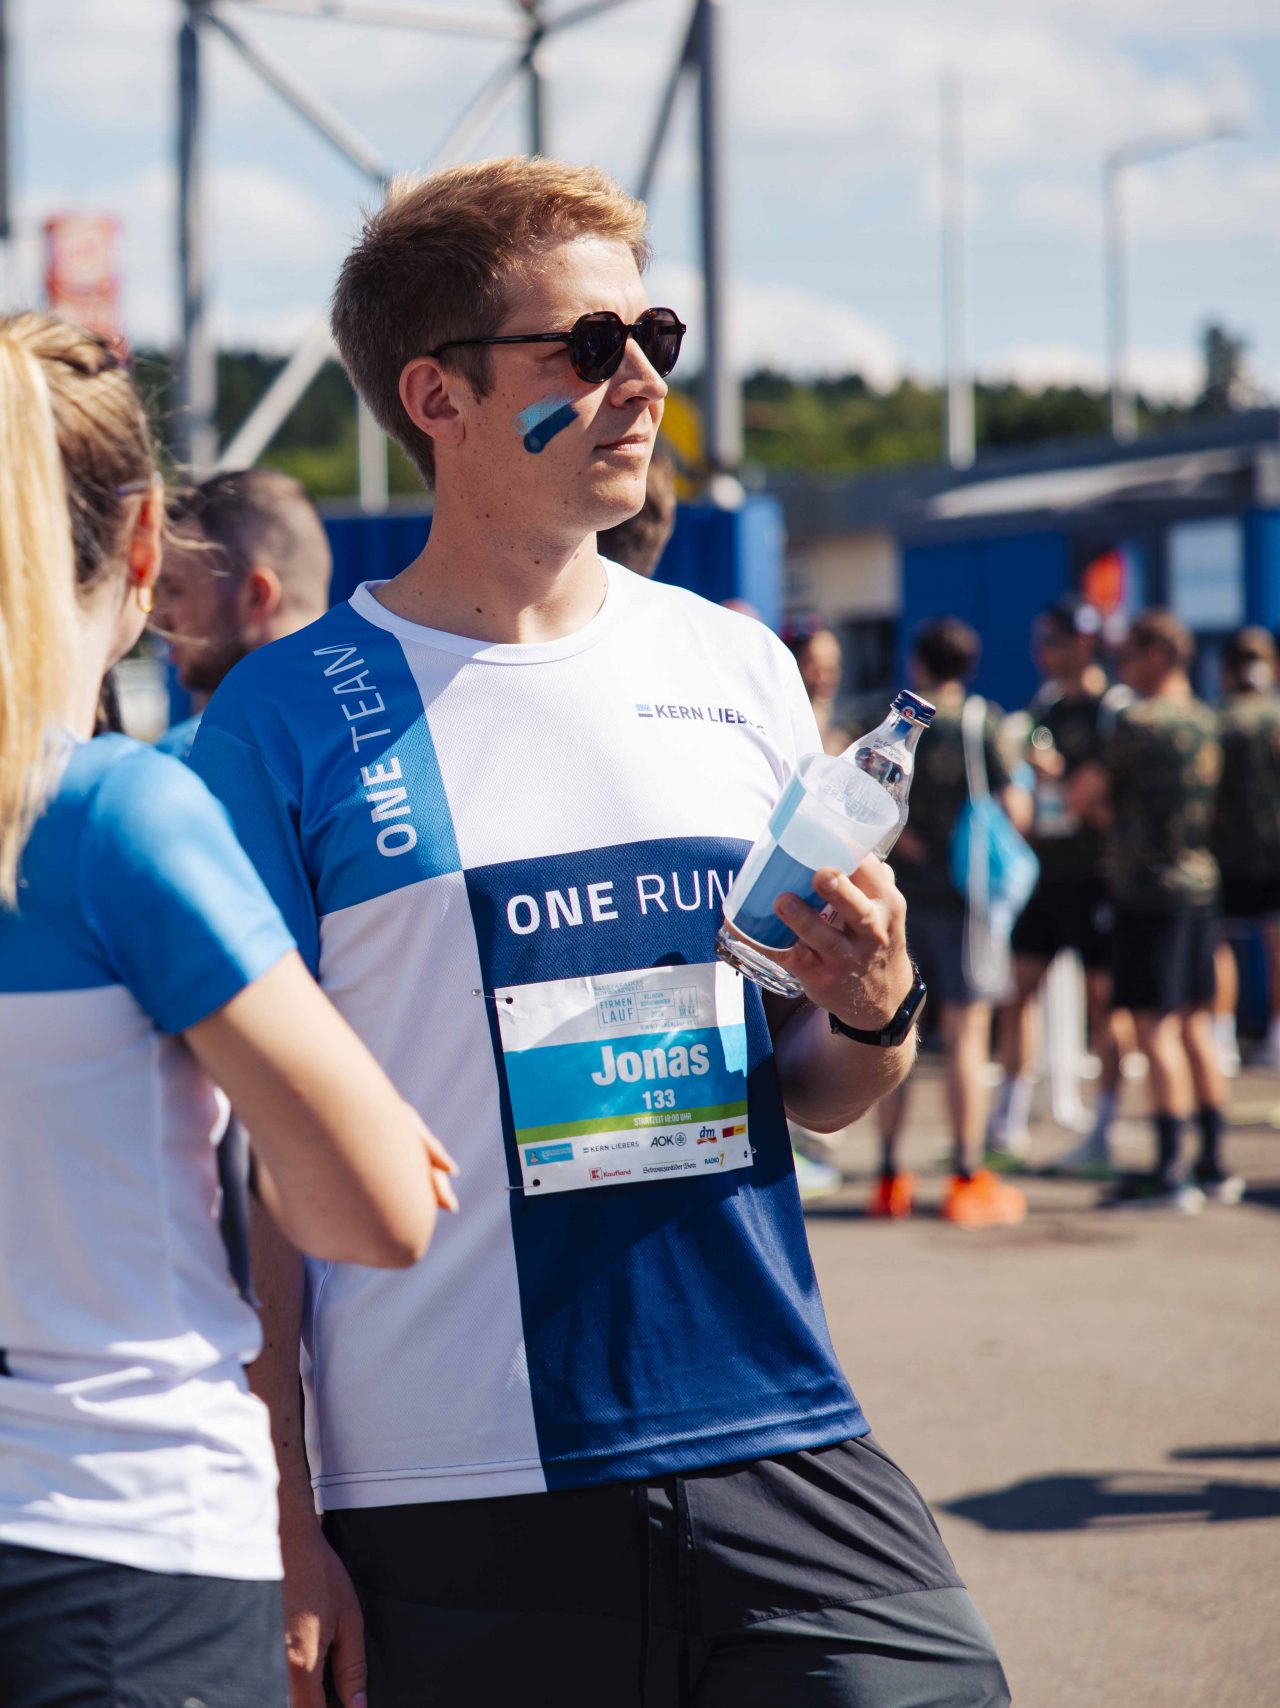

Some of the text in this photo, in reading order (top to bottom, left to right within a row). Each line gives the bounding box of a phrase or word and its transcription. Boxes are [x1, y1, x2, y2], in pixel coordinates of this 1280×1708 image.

[654, 704, 704, 721] KERN
[313, 643, 417, 858] ONE TEAM
[506, 869, 734, 935] ONE RUN
[600, 997, 632, 1009] FIRMEN
[601, 1008, 634, 1024] LAUF
[592, 1043, 710, 1086] Jonas
[642, 1088, 676, 1110] 133
[699, 1126, 715, 1138] dm
[590, 1141, 639, 1153] KERN LIEBERS
[650, 1136, 675, 1147] AOK
[704, 1156, 720, 1165] RADIO
[603, 1169, 632, 1178] Kaufland
